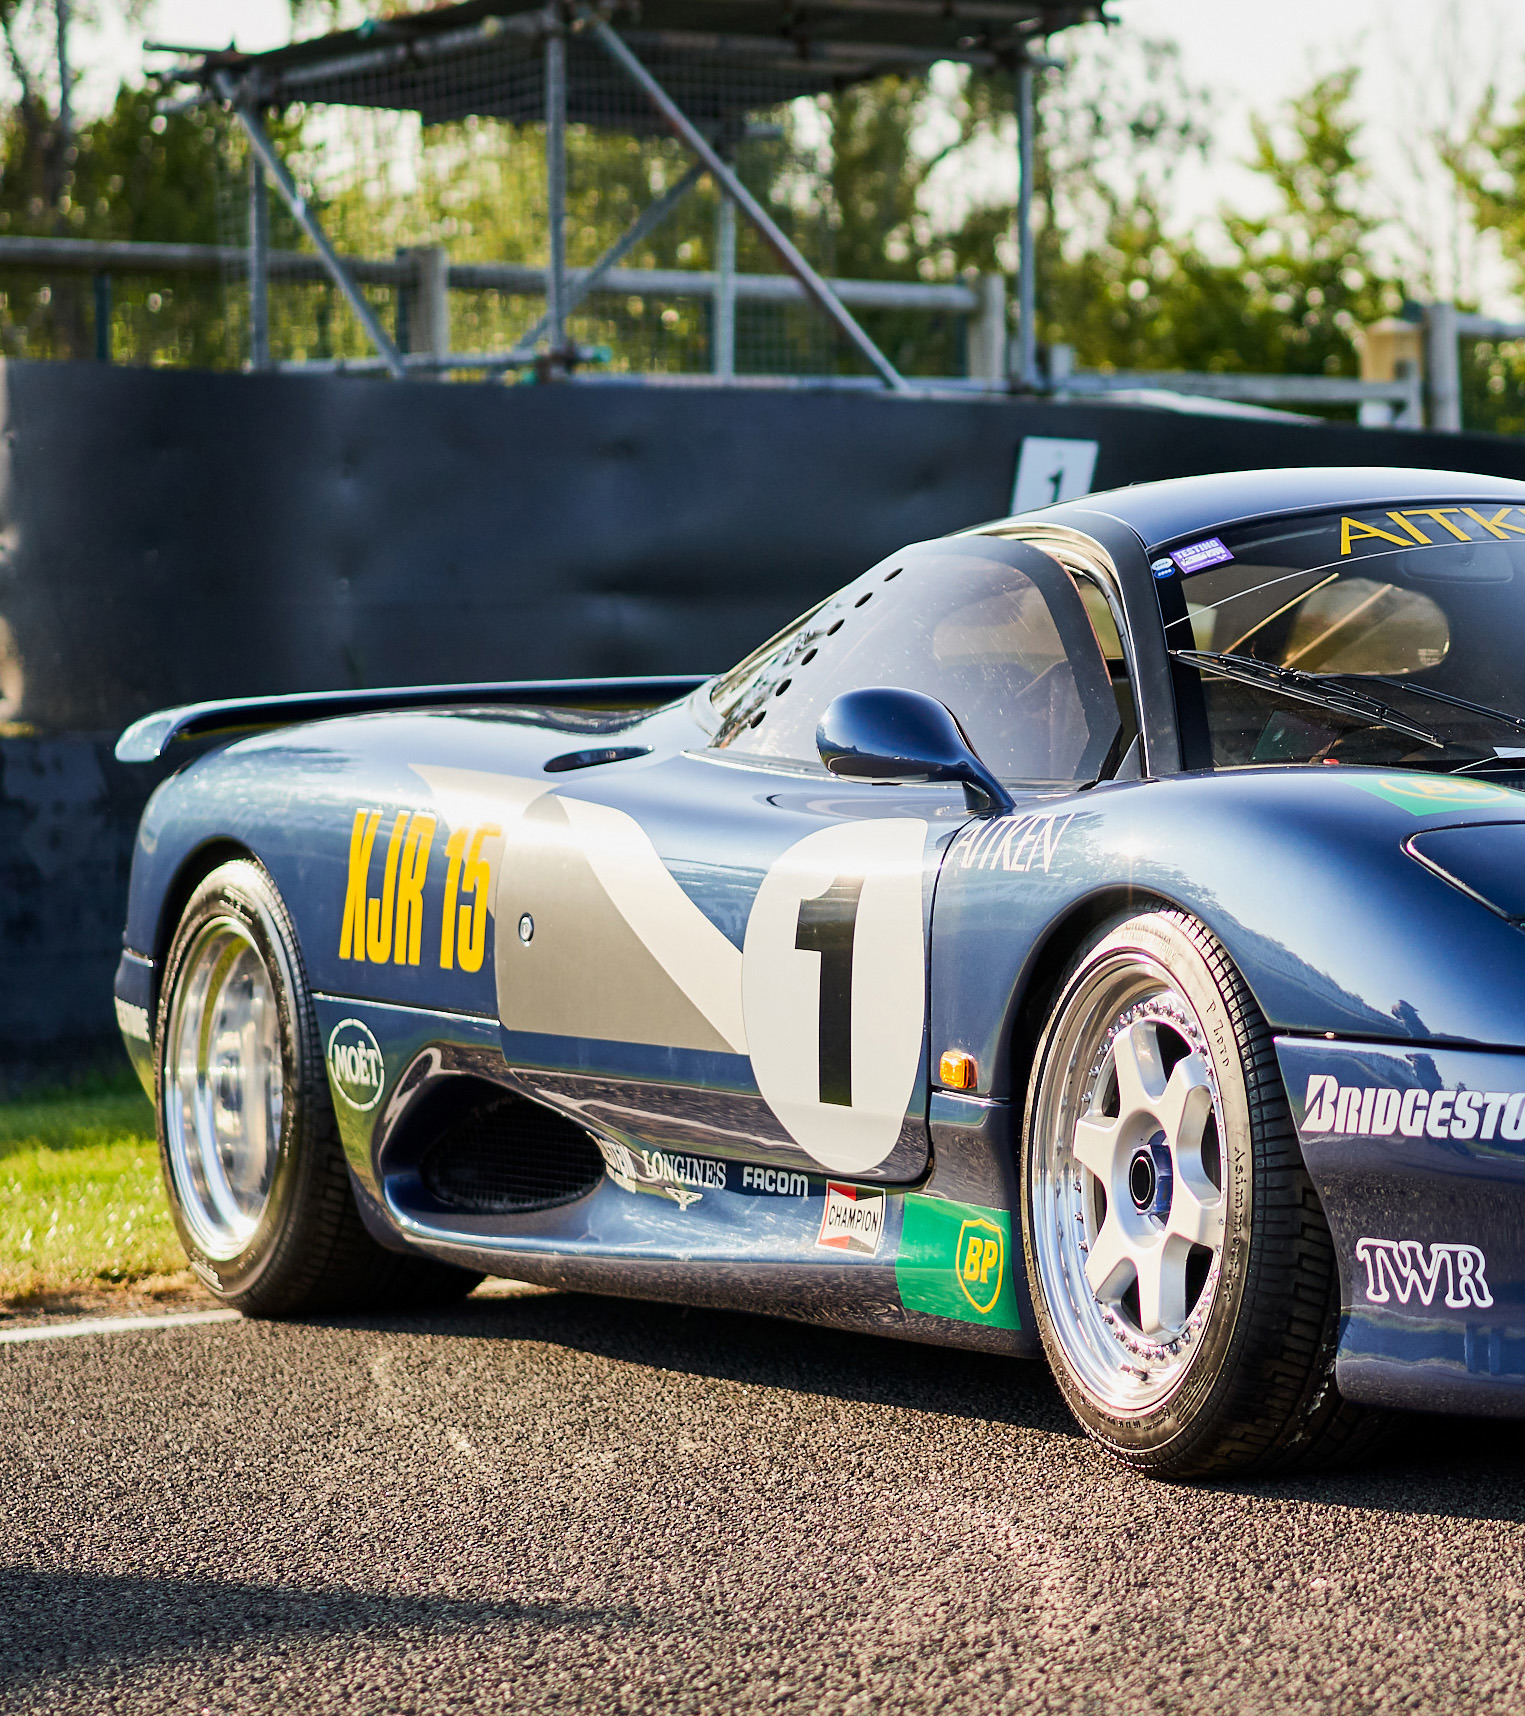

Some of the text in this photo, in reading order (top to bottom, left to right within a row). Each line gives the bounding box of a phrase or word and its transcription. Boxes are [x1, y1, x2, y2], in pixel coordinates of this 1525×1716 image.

[1173, 540, 1219, 559] TESTING
[942, 813, 1076, 873] AITKEN
[338, 807, 503, 974] XJR 15
[795, 874, 866, 1108] 1
[333, 1040, 379, 1088] MOËT
[641, 1149, 727, 1190] LONGINES
[742, 1166, 809, 1201] FACOM
[828, 1204, 880, 1234] CHAMPION
[963, 1236, 999, 1284] BP
[1355, 1237, 1494, 1308] TWR
